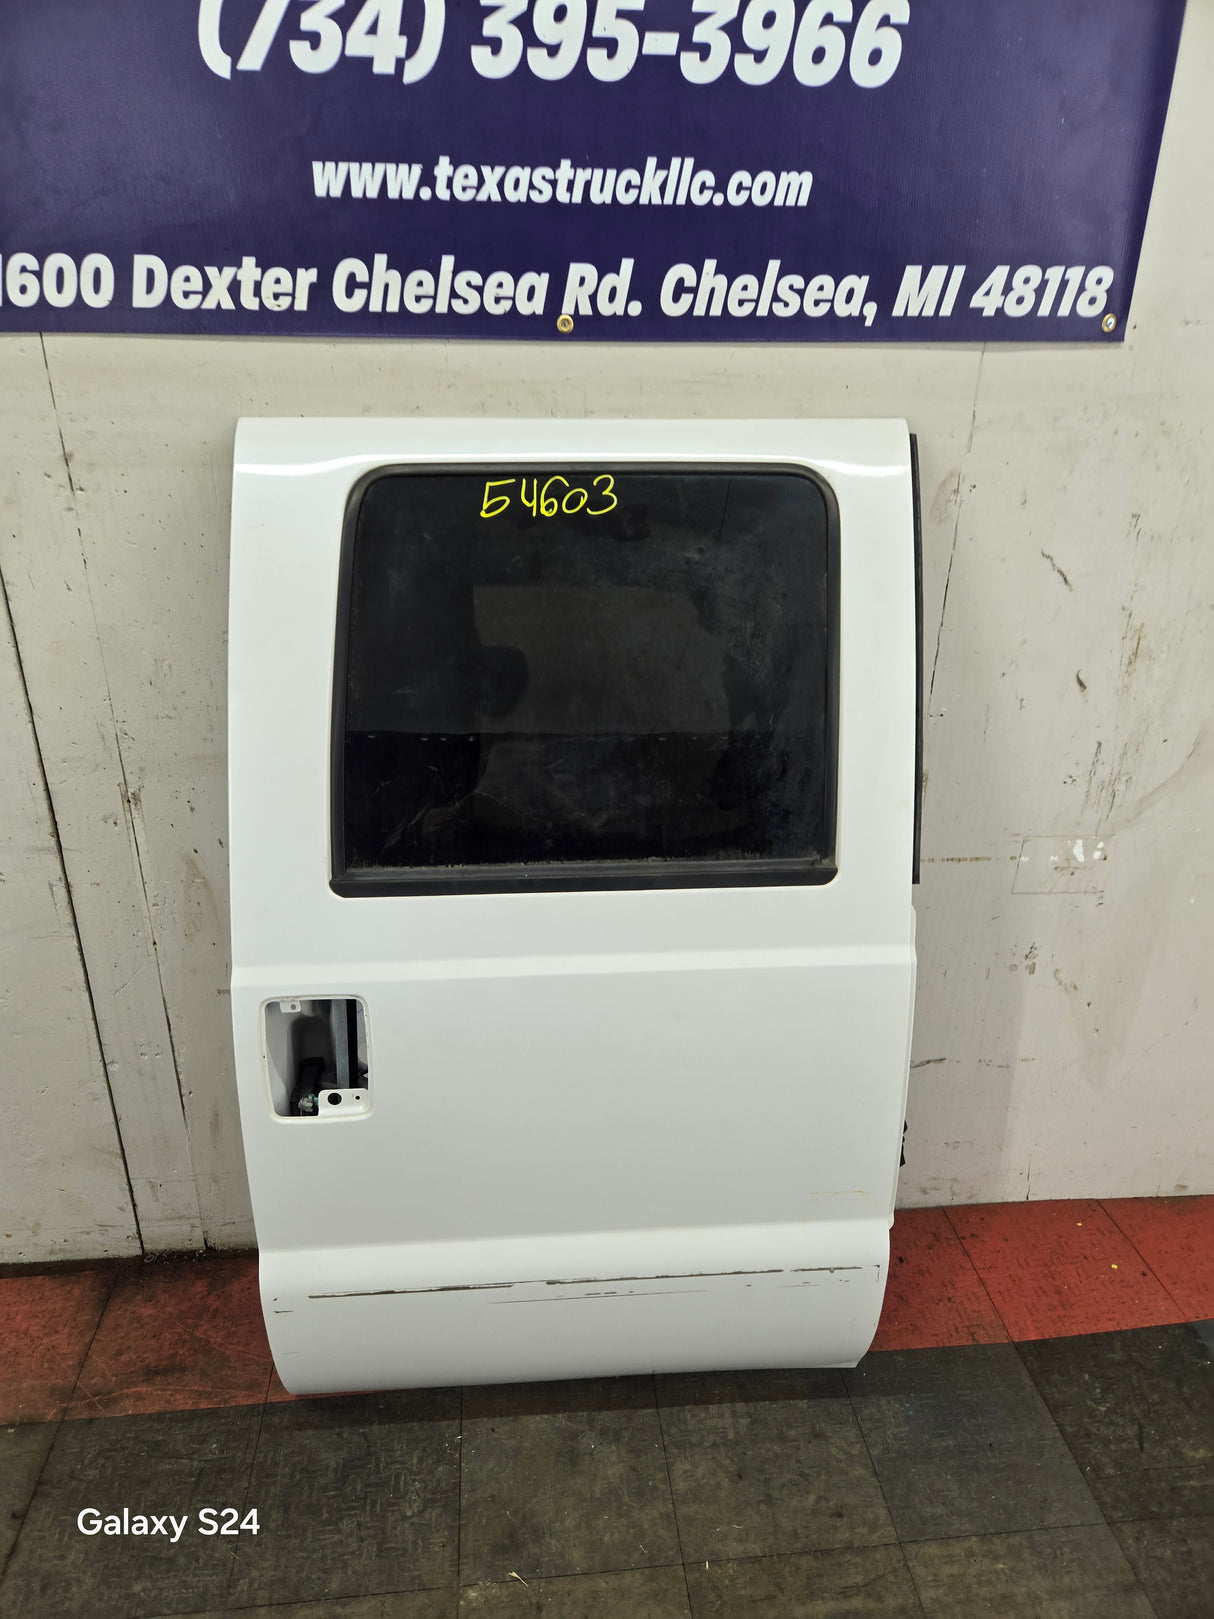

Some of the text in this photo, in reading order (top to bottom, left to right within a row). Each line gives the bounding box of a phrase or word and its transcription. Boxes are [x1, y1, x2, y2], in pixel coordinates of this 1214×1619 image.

[198, 0, 910, 88] (734) 395-3966
[312, 156, 813, 206] www.texastruckllc.com
[0, 253, 1113, 326] 600 Dexter Chelsea Rd. Chelsea, MI 48118
[480, 474, 618, 518] 54603
